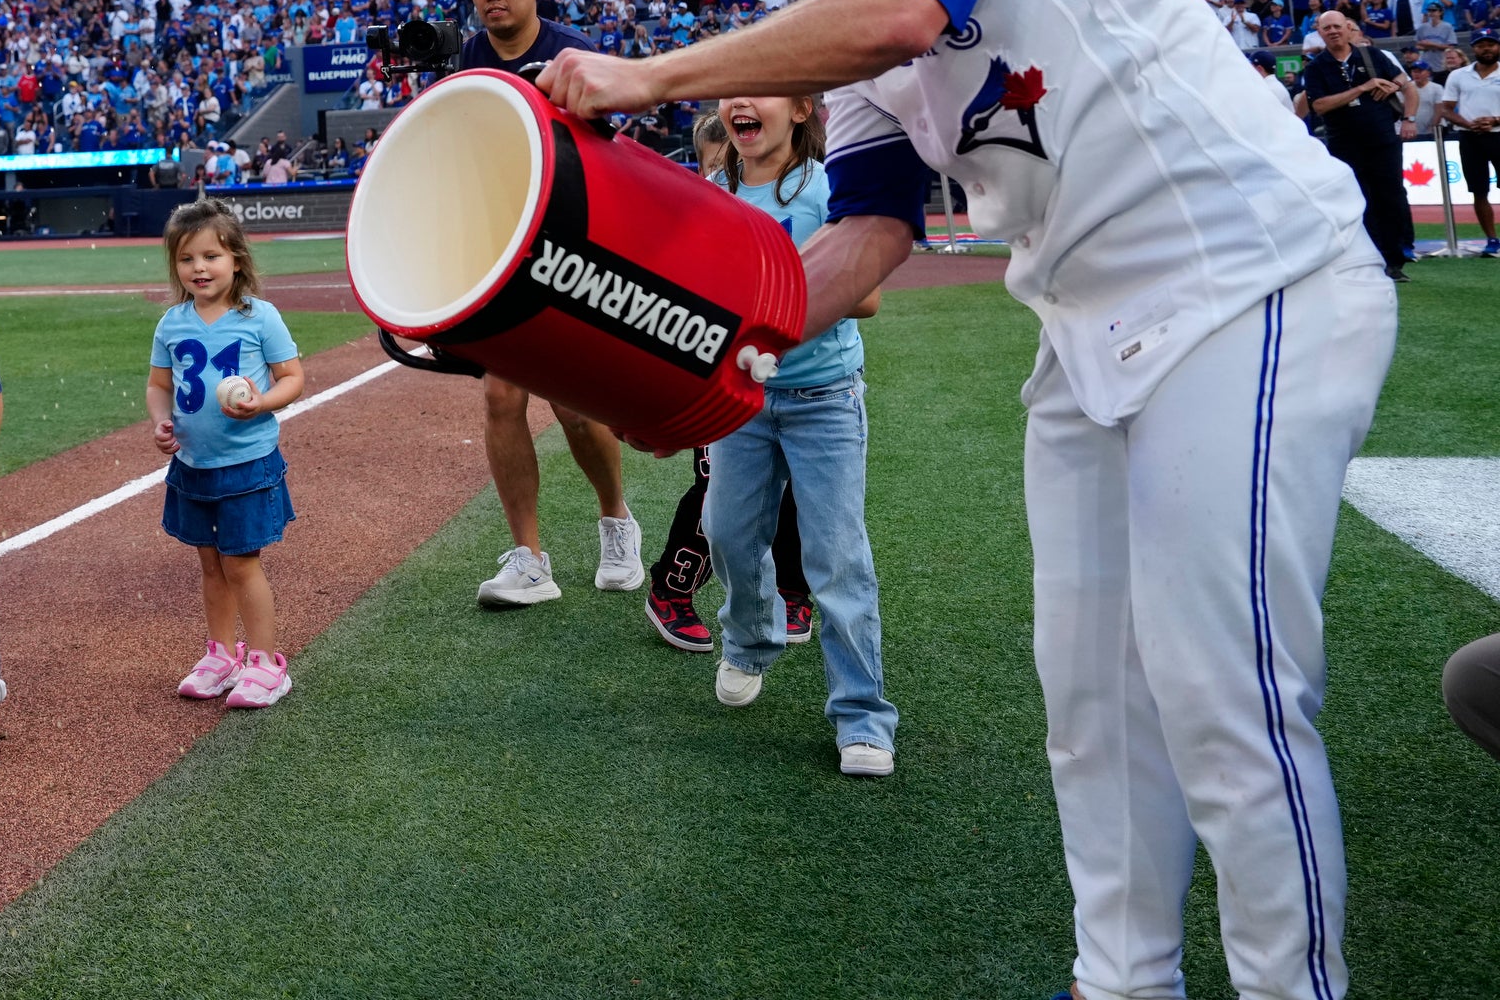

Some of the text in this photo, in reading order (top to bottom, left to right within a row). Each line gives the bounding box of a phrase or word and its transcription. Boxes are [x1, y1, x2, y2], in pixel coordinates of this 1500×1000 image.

[331, 52, 367, 66] KPMG
[1279, 59, 1301, 74] TD
[308, 69, 365, 81] BLUEPRINT
[244, 202, 304, 220] clover
[529, 239, 729, 365] BODYARMOR
[173, 338, 243, 414] 31
